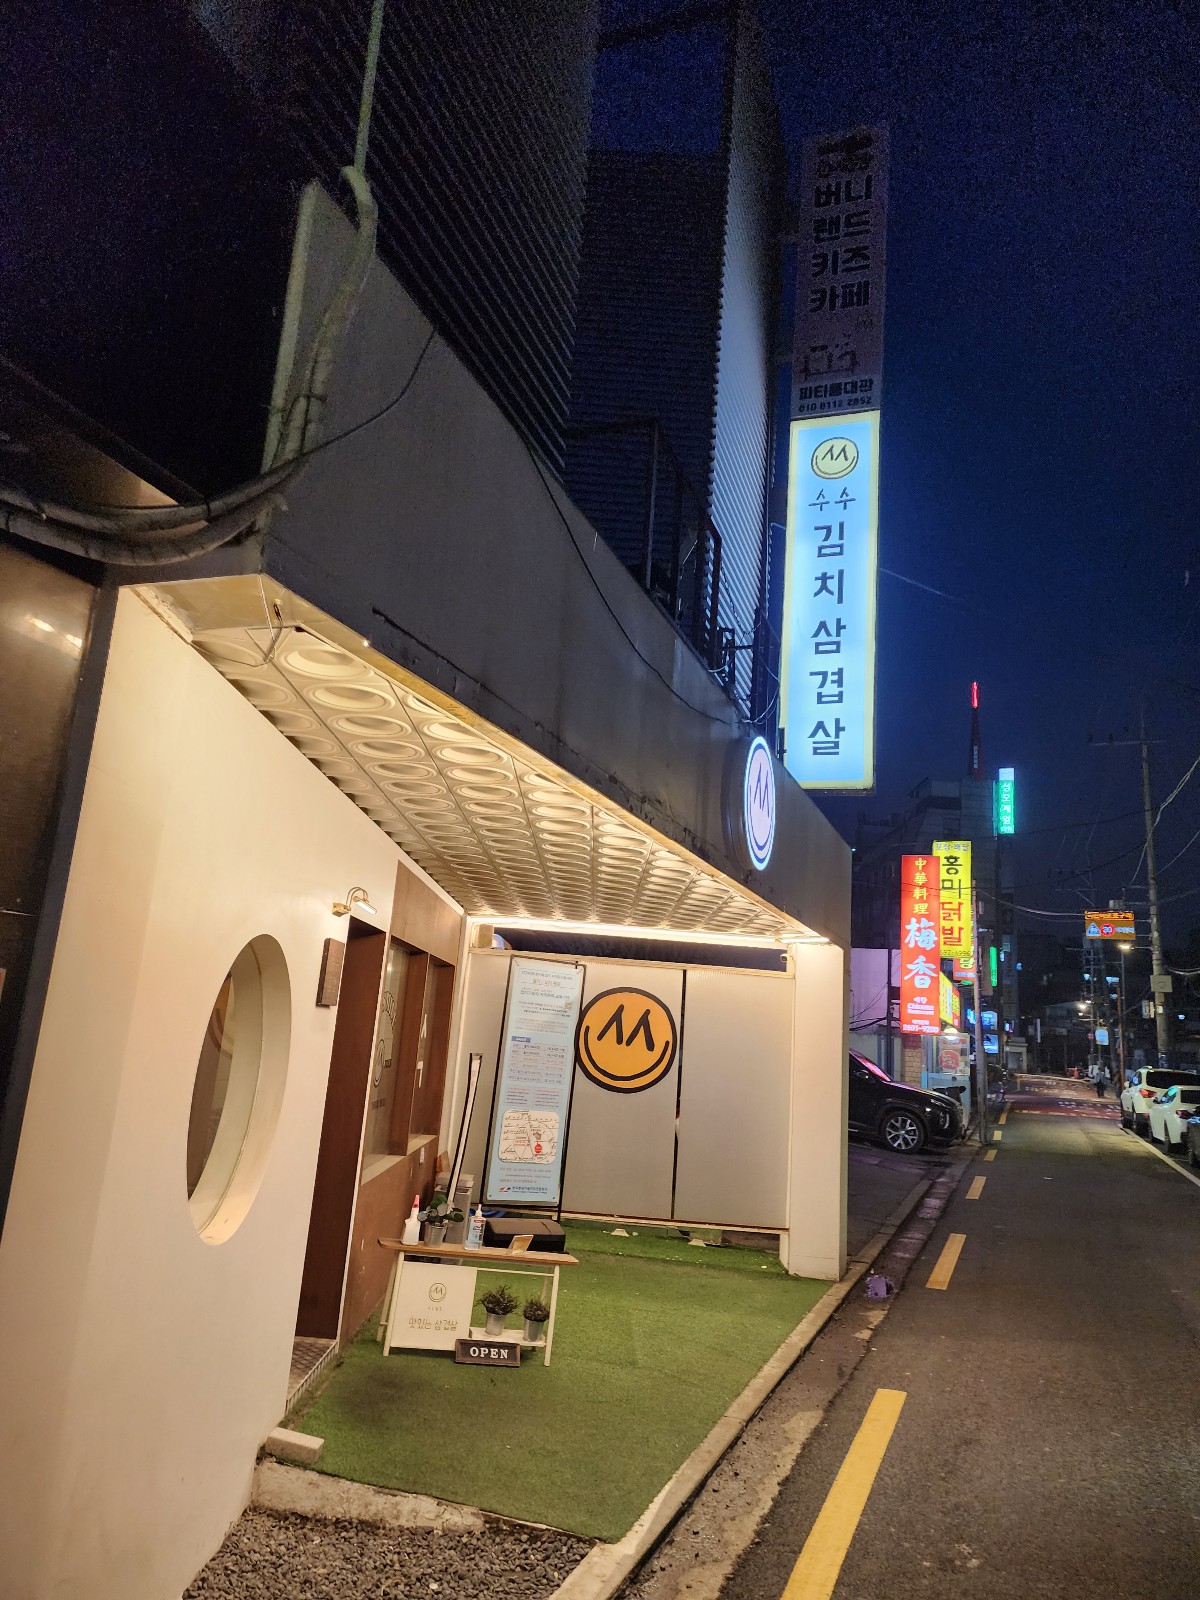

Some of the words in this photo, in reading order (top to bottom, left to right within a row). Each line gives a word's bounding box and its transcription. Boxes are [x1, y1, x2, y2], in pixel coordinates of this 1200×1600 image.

[813, 174, 873, 208] 버니
[812, 209, 871, 245] 랜드
[811, 245, 871, 278] 키즈
[809, 280, 870, 313] 카페
[808, 486, 857, 512] 수수
[807, 520, 847, 756] 김치삼겹살
[912, 857, 930, 915] 中華料理
[903, 917, 939, 989] 梅香
[408, 1317, 432, 1330] 맛있는
[469, 1347, 508, 1359] OPEN
